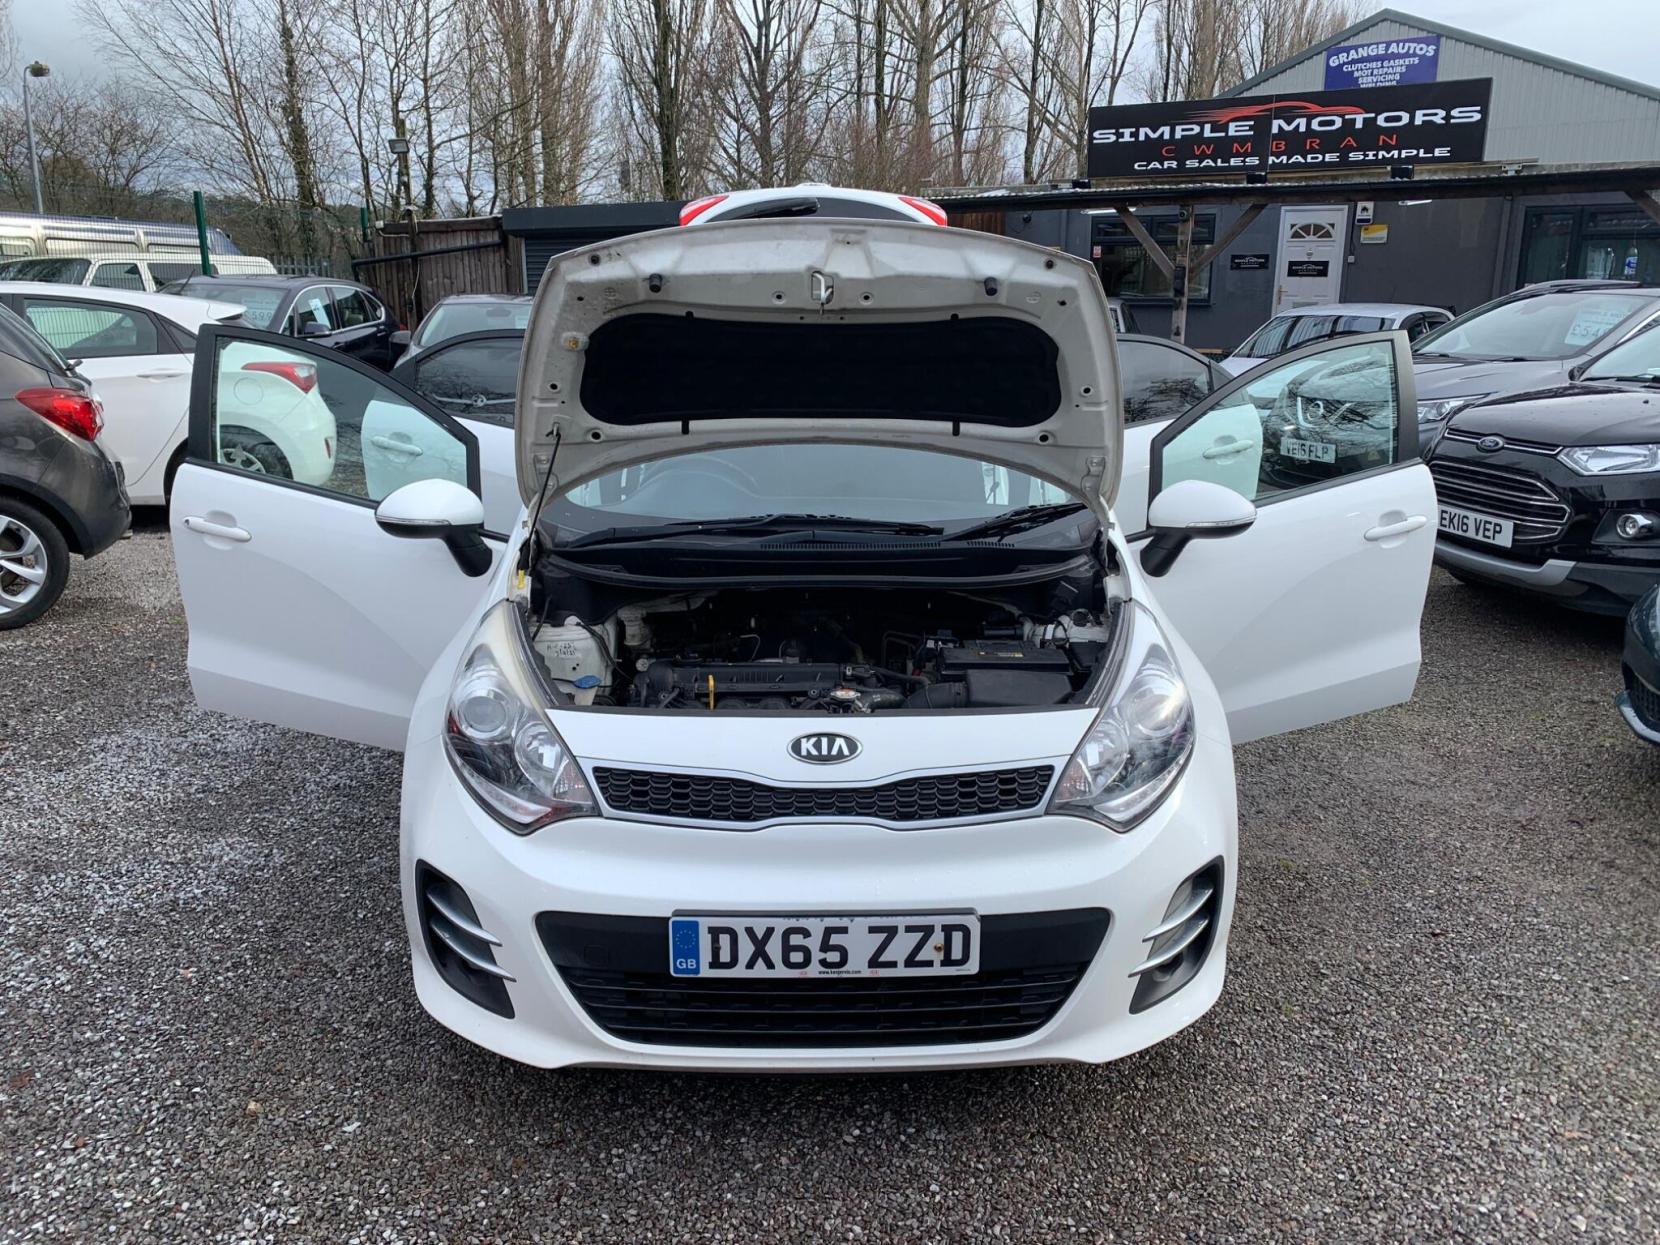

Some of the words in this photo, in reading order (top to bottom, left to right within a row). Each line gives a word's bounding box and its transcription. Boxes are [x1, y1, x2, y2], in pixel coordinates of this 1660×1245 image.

[1329, 44, 1387, 67] GRANGE
[1388, 43, 1437, 56] AUTOS
[1343, 61, 1382, 72] CLUTCHES
[1383, 57, 1420, 68] GASKETS
[1353, 69, 1372, 77] MOT
[1373, 66, 1407, 76] REPAIRS
[1358, 73, 1400, 84] SERVICING
[1092, 120, 1255, 144] SIMPLE
[1272, 106, 1482, 134] MOTORS
[1133, 160, 1178, 170] CAR
[1185, 156, 1260, 168] SALES
[1268, 153, 1340, 165] MADE
[1348, 147, 1451, 161] SIMPLE
[1440, 509, 1470, 533] EK16
[1473, 517, 1503, 541] VEP
[800, 736, 851, 756] KIA
[707, 926, 849, 970] DX65
[867, 923, 972, 969] ZZD
[676, 958, 697, 969] GB
